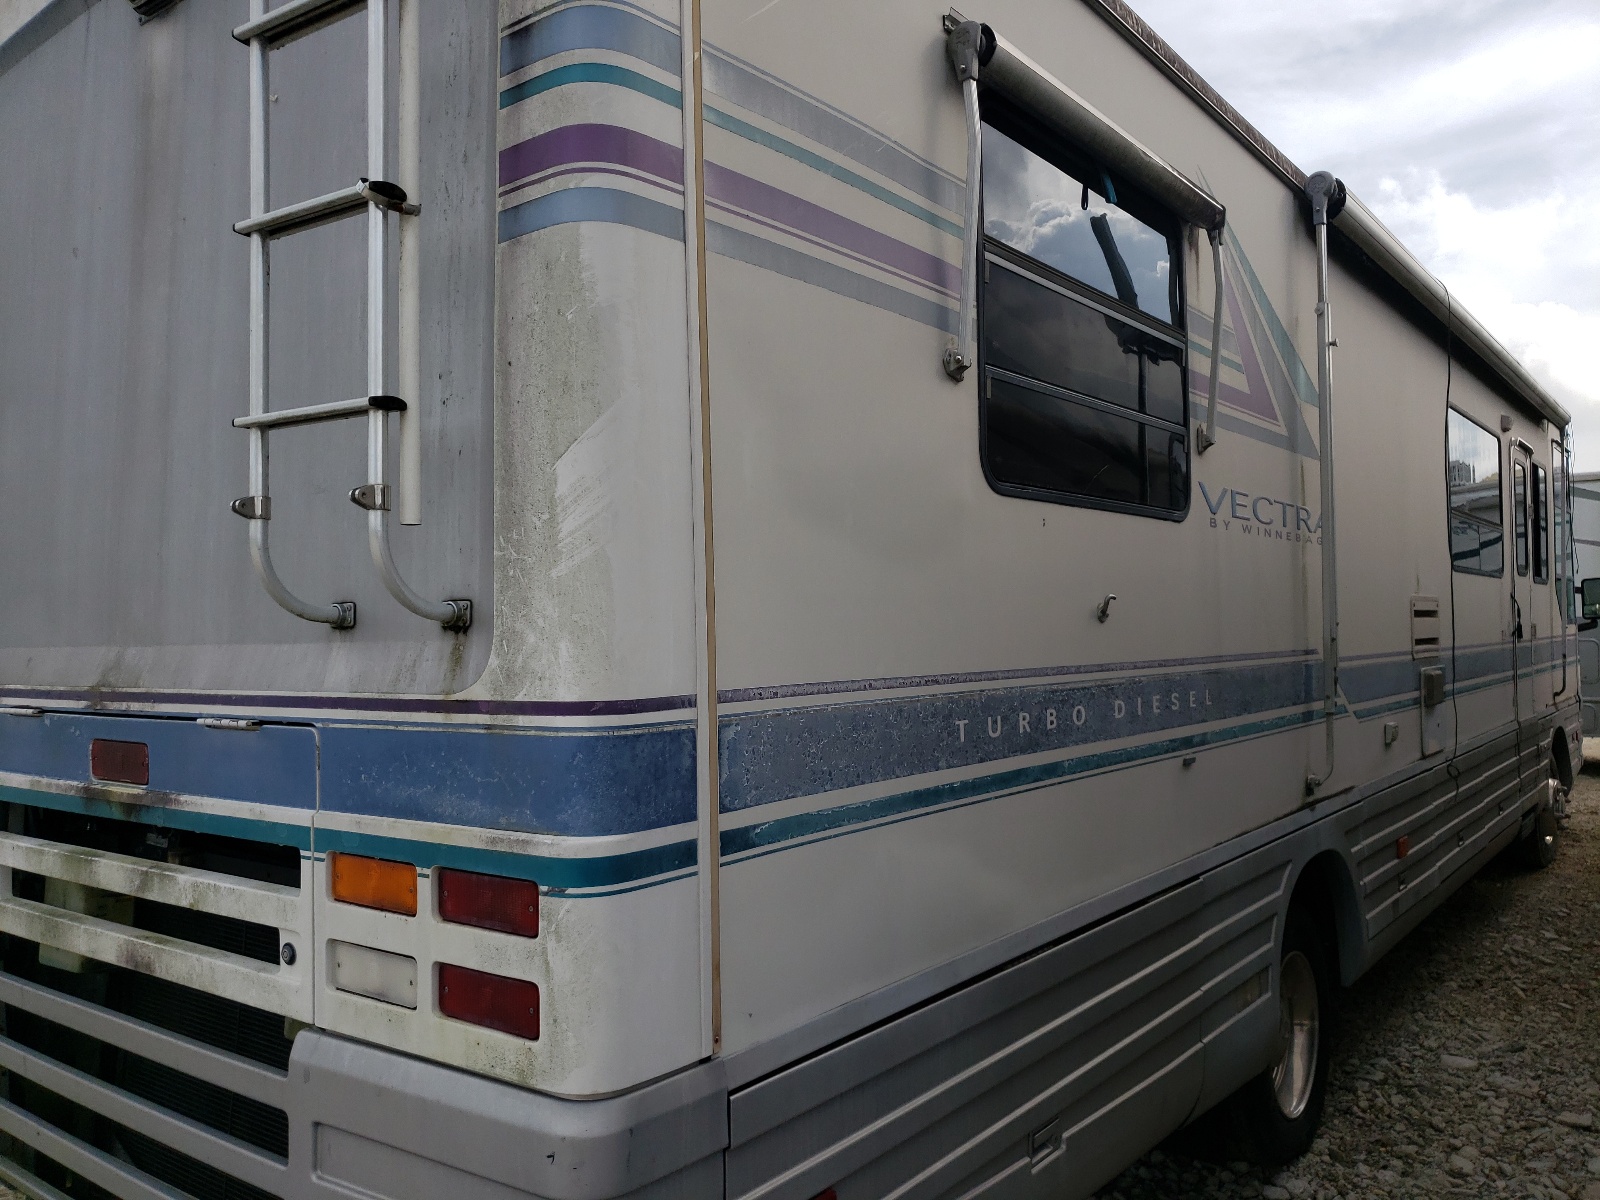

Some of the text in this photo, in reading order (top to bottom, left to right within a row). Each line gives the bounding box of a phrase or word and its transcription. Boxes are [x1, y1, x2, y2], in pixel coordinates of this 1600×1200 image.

[1210, 517, 1323, 545] BY WINNEBAG
[955, 690, 1212, 743] TURBO DIESEL
